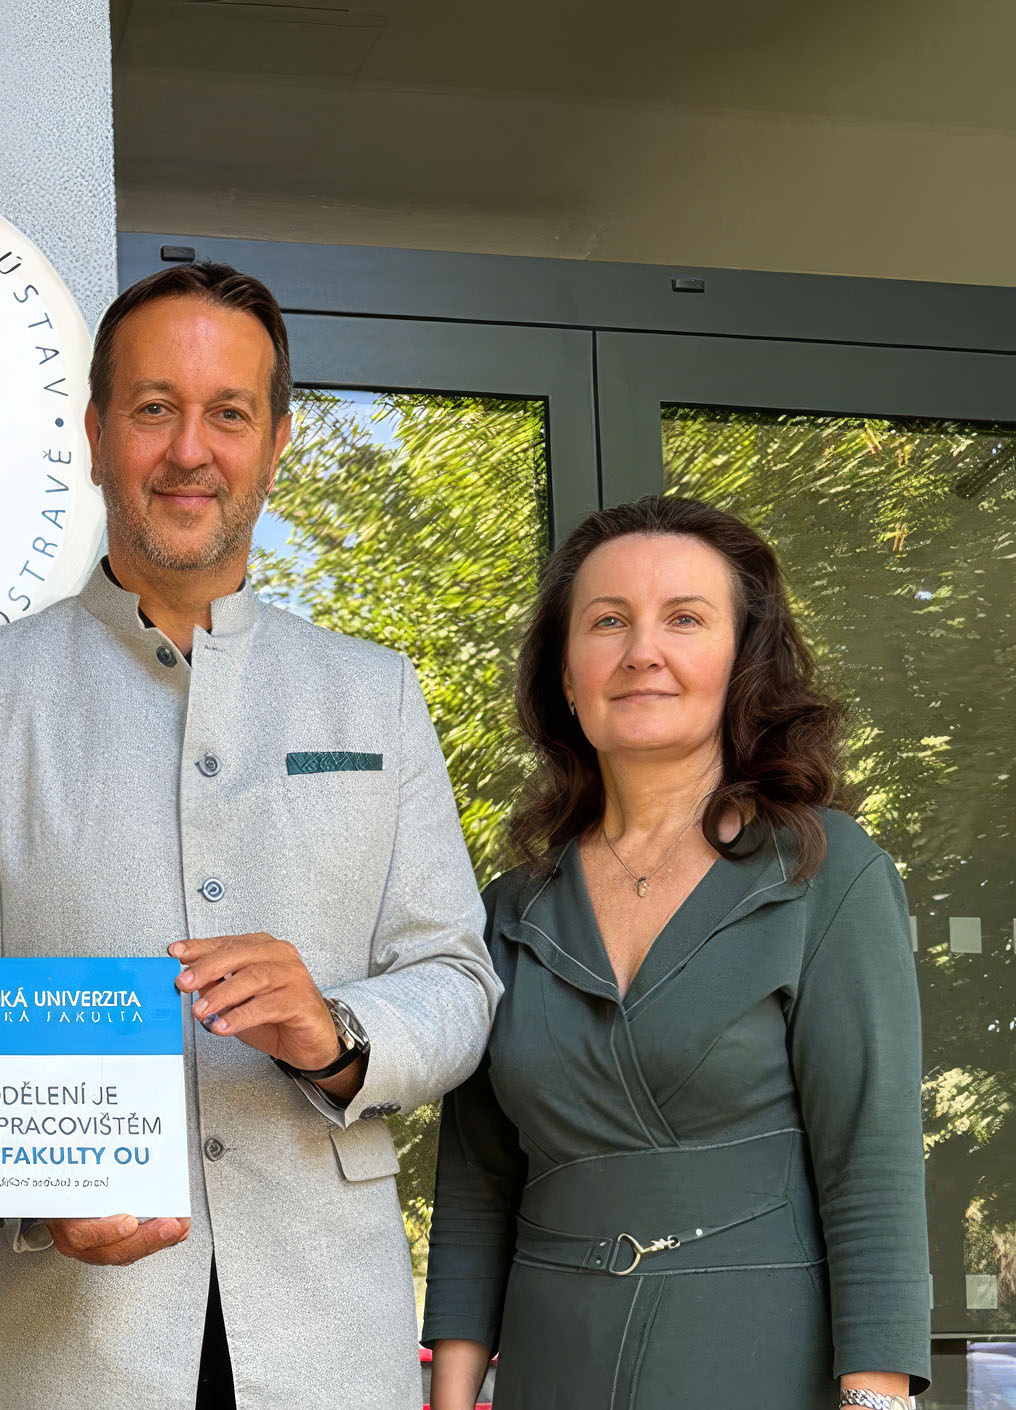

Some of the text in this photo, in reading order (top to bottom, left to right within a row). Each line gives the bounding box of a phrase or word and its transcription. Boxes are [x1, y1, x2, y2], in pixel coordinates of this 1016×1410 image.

[34, 990, 142, 1008] UNIVERZITA
[92, 1085, 118, 1107] JE
[2, 1146, 106, 1165] FAKULTY
[113, 1146, 150, 1165] OU
